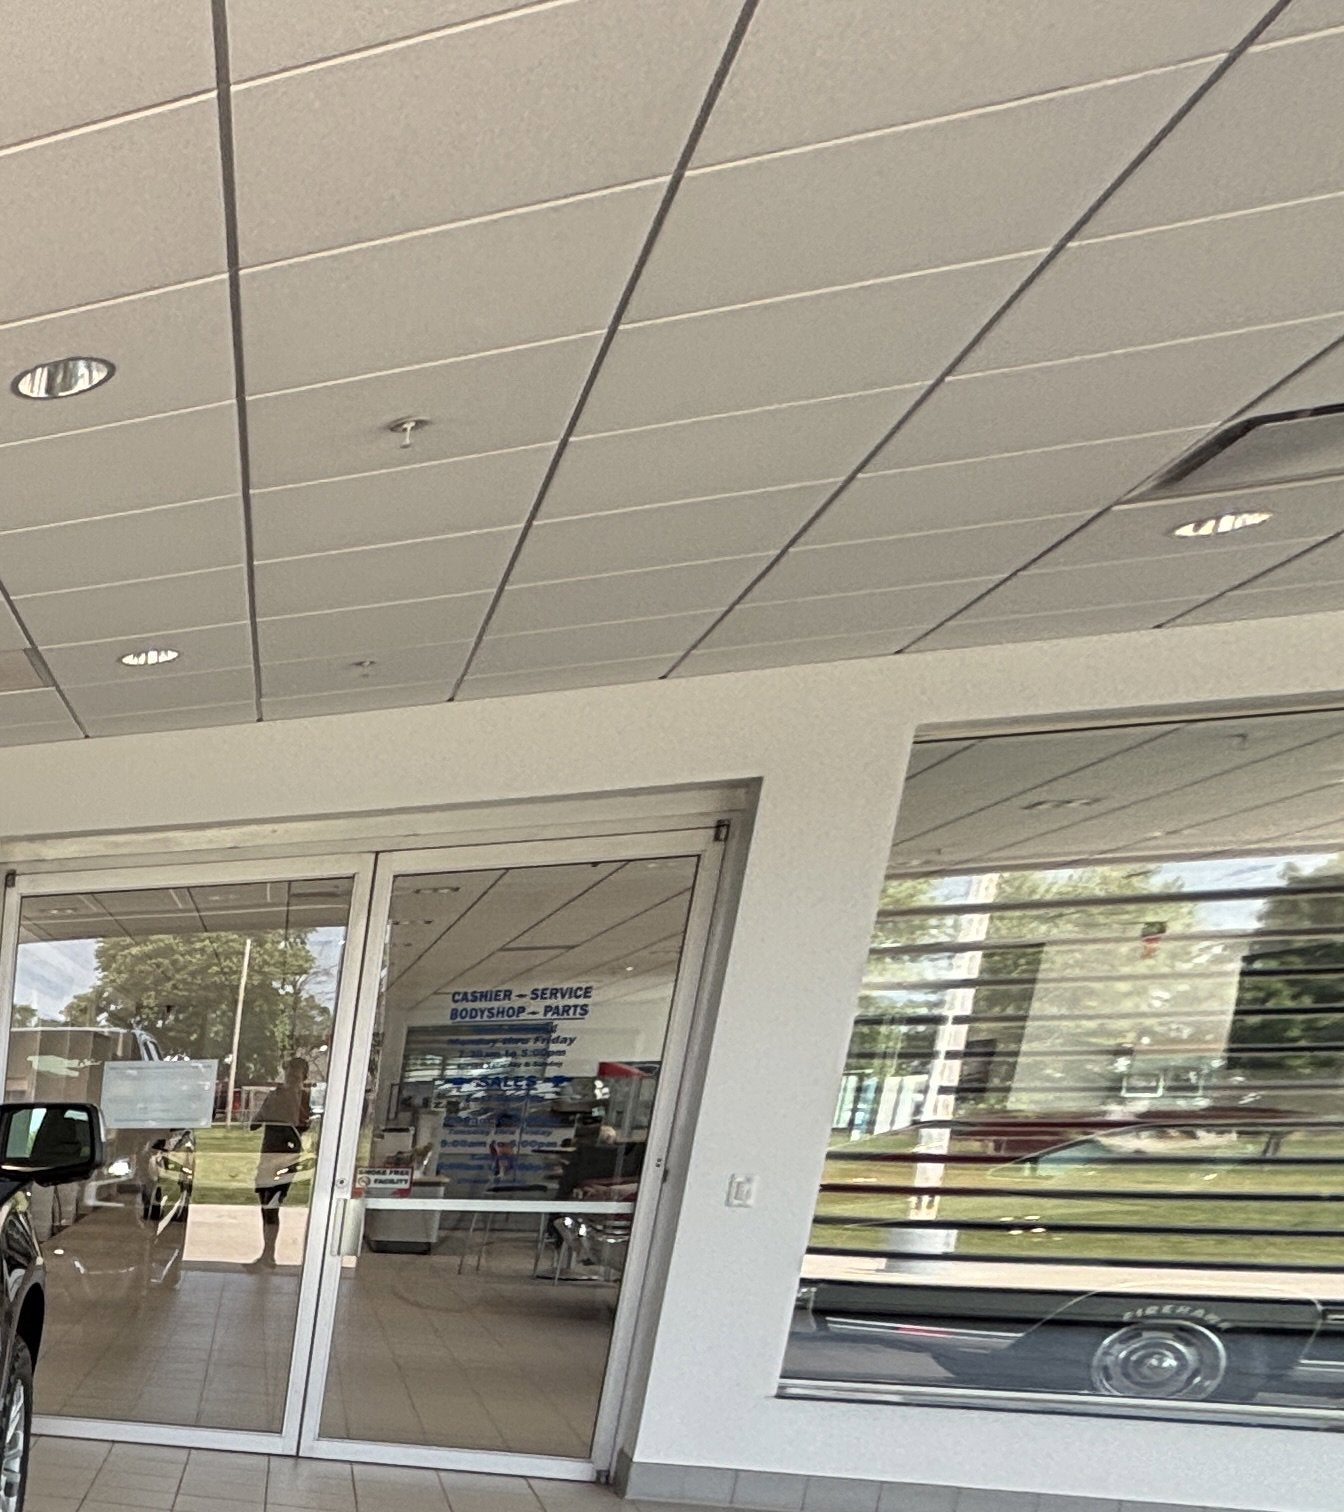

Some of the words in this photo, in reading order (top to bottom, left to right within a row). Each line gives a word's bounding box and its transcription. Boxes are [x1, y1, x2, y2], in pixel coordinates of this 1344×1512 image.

[451, 989, 512, 1003] CASHIER
[529, 986, 593, 1000] SERVICE
[449, 1006, 526, 1021] BODYSHOP
[543, 1004, 589, 1018] PARTS
[533, 1035, 577, 1046] Friday
